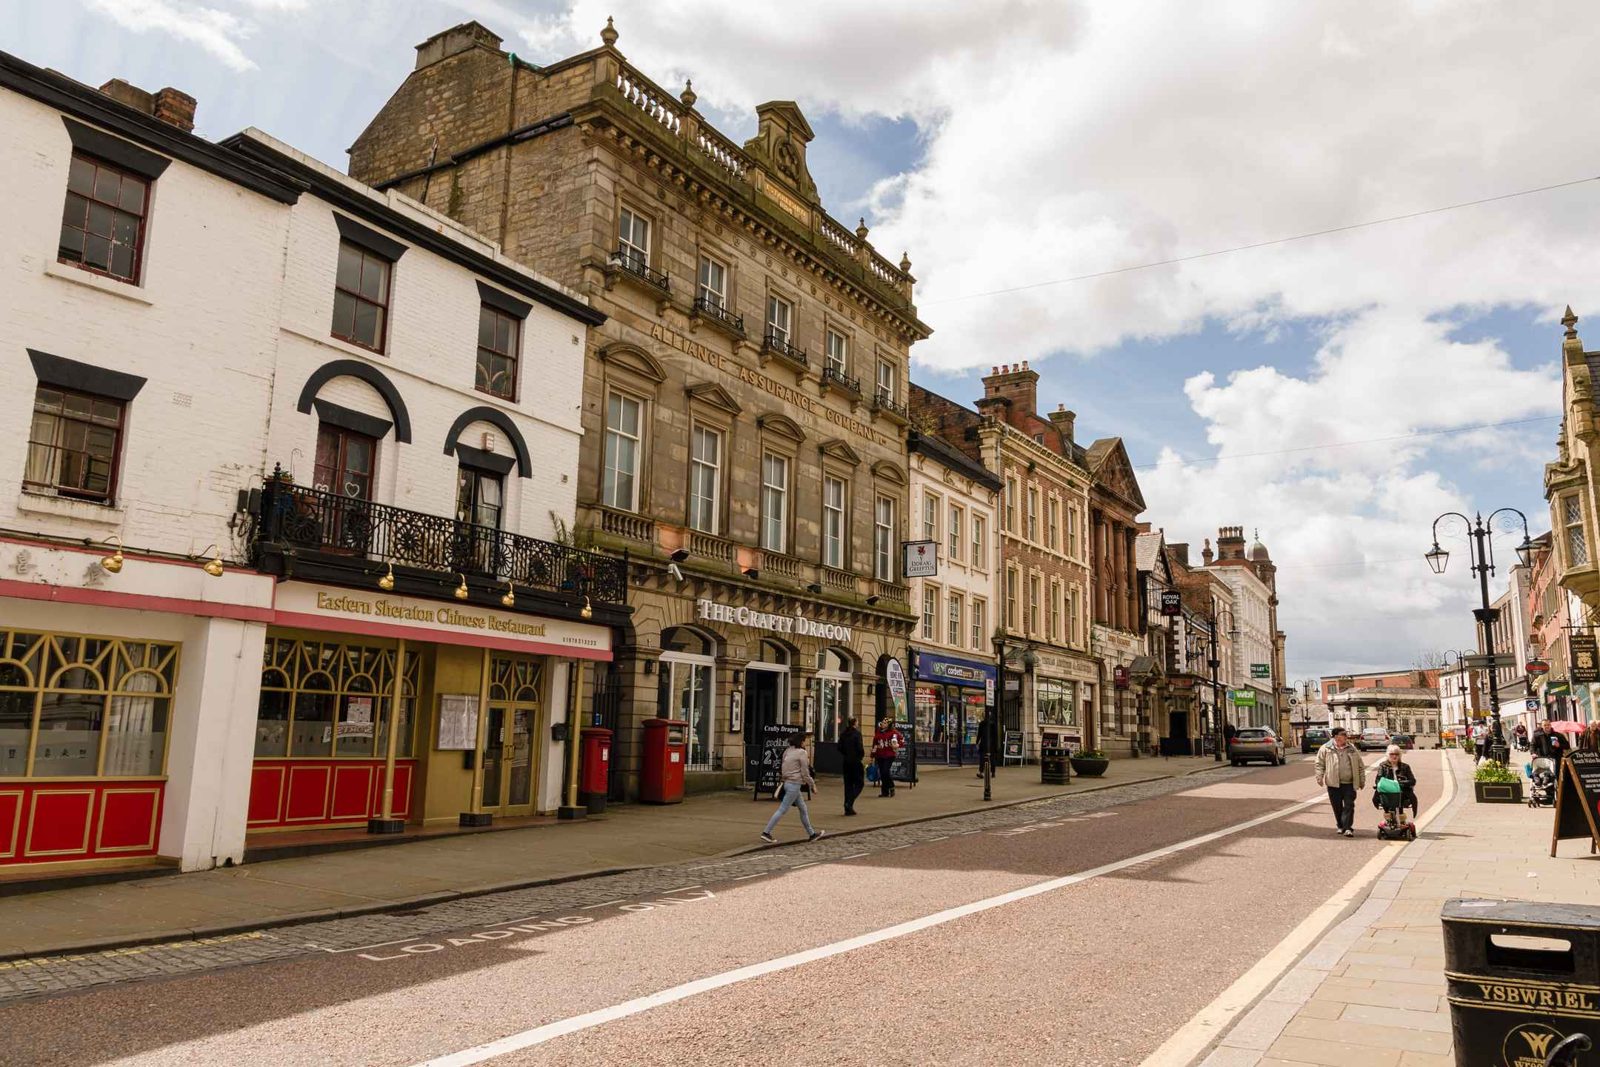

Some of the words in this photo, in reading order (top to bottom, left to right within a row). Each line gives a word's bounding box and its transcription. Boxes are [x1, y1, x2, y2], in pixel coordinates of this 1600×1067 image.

[652, 324, 727, 370] ALLIANCE
[740, 367, 817, 413] ASSURANCE
[826, 409, 880, 441] COMPANY
[317, 592, 371, 614] Eastern
[375, 600, 435, 623] Sheraton
[437, 608, 486, 628] Chinese
[488, 615, 546, 637] Restaurant
[698, 599, 735, 624] THE
[735, 607, 793, 633] CRAFTY
[795, 616, 851, 641] DRAGON
[358, 914, 594, 961] LOADING
[618, 889, 716, 912] ONLY
[1479, 984, 1593, 1010] YSBWRIEL
